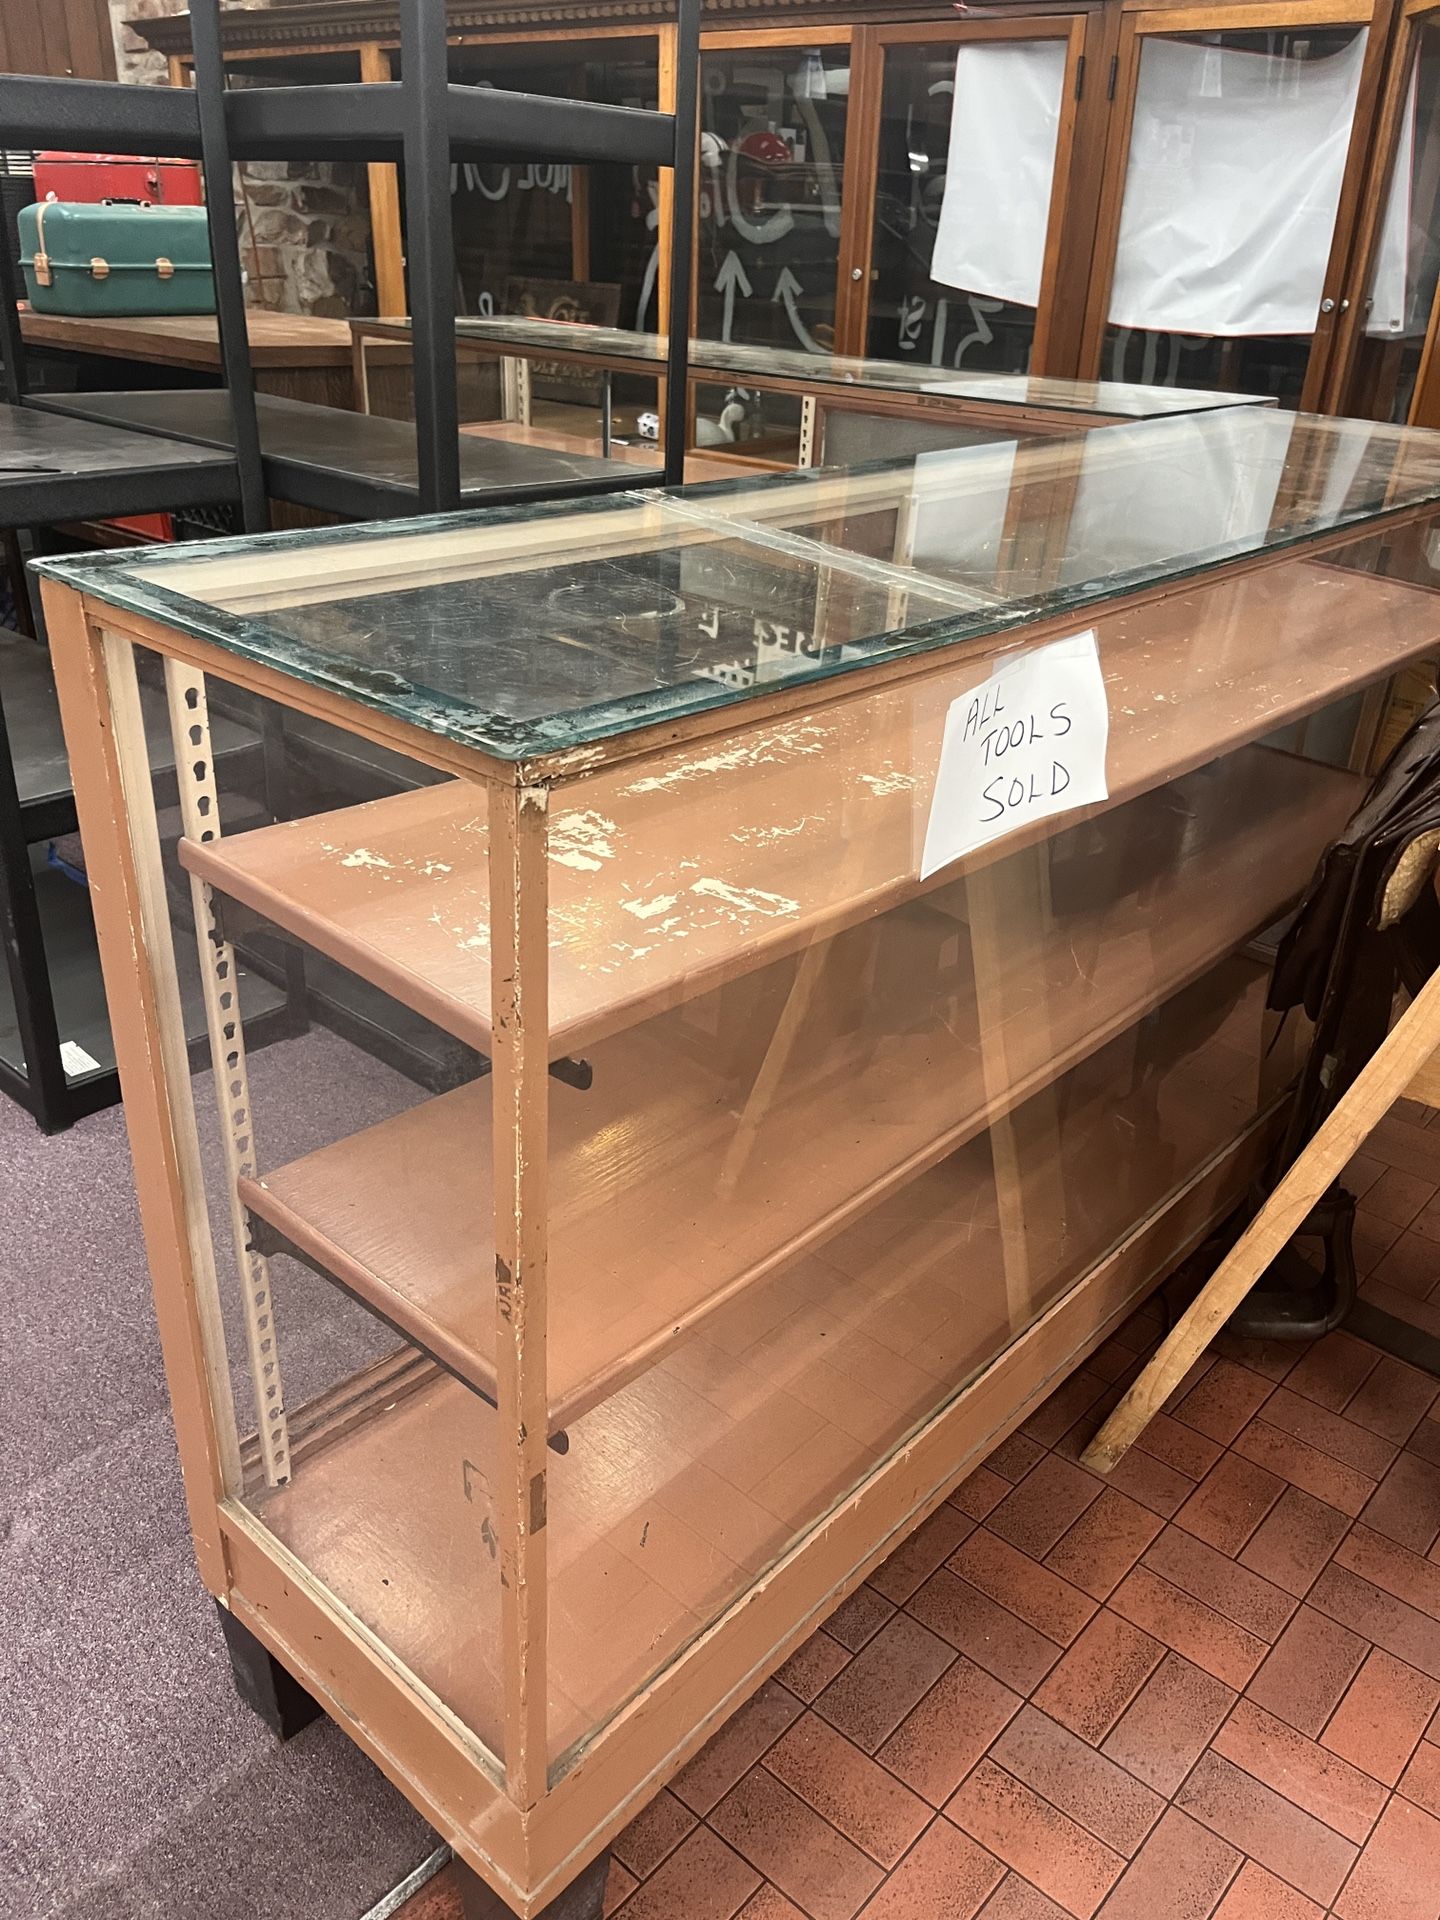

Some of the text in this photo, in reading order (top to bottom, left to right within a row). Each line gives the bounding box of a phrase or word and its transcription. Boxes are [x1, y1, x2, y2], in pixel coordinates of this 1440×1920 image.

[963, 684, 1005, 743] ALL
[980, 702, 1072, 766] TOOLS
[978, 760, 1070, 823] SOLD
